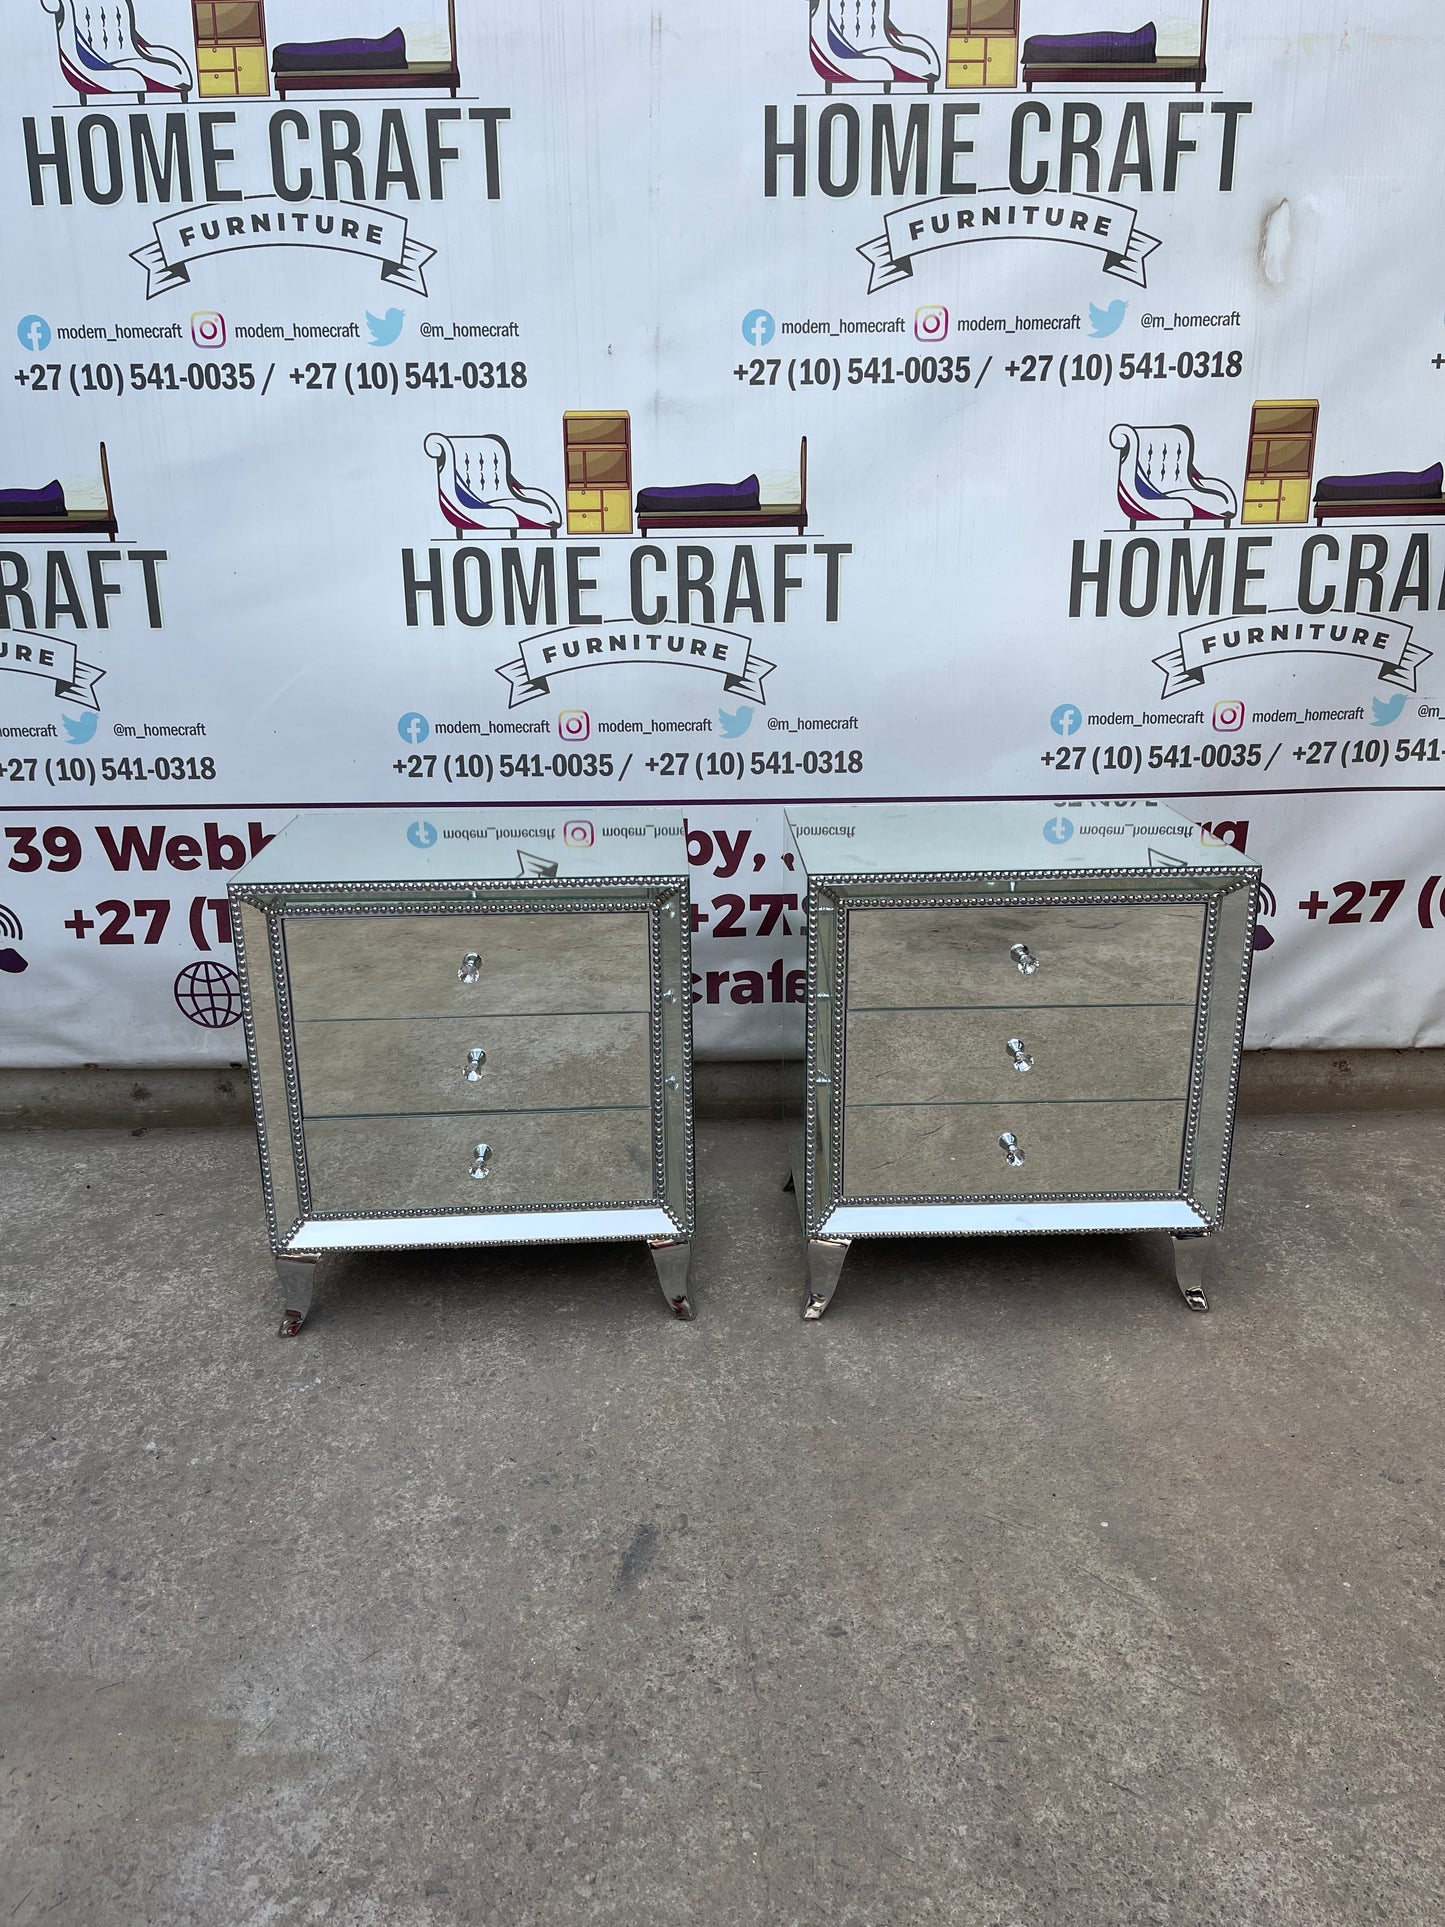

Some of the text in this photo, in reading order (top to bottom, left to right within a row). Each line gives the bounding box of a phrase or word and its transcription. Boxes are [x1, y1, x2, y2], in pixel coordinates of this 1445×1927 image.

[22, 107, 511, 205] HOME CRAFT
[764, 101, 1252, 197] HOME CRAFT
[179, 212, 384, 248] FURNITURE
[909, 205, 1112, 241] FURNITURE
[419, 322, 520, 341] @m_homecraft
[1140, 311, 1241, 331] @m_homecraft
[14, 363, 62, 391] +27
[69, 363, 124, 397] (10)
[130, 362, 256, 391] 541-0035
[289, 362, 337, 390] +27
[344, 362, 399, 396] (10)
[405, 361, 528, 390] 541-0318
[733, 358, 782, 386] +27
[787, 357, 841, 392] (10)
[847, 355, 971, 385] 541-0035
[1004, 354, 1054, 382] +27
[1059, 353, 1113, 388] (10)
[1118, 350, 1243, 380] 541-0318
[402, 543, 853, 626] HOME CRAFT
[1068, 532, 1445, 617] HOME CRA
[543, 633, 730, 664] FURNITURE
[1202, 623, 1390, 652] FURNITURE
[113, 722, 207, 739] @m_homecraft
[767, 716, 859, 733] @m_homecraft
[45, 757, 96, 787] (10)
[101, 756, 217, 781] 541-0318
[392, 754, 438, 778] +27
[443, 754, 494, 783] (10)
[499, 753, 614, 778] 541-0035
[645, 752, 690, 776] +27
[695, 751, 745, 781] (10)
[750, 749, 864, 775] 541-0318
[1040, 746, 1087, 771] +27
[1092, 745, 1142, 775] (10)
[1147, 743, 1262, 769] 541-0035
[1292, 741, 1338, 765] +27
[1340, 739, 1390, 769] (10)
[4, 826, 82, 873] 39
[1298, 879, 1406, 925] +27
[64, 899, 171, 945] +27
